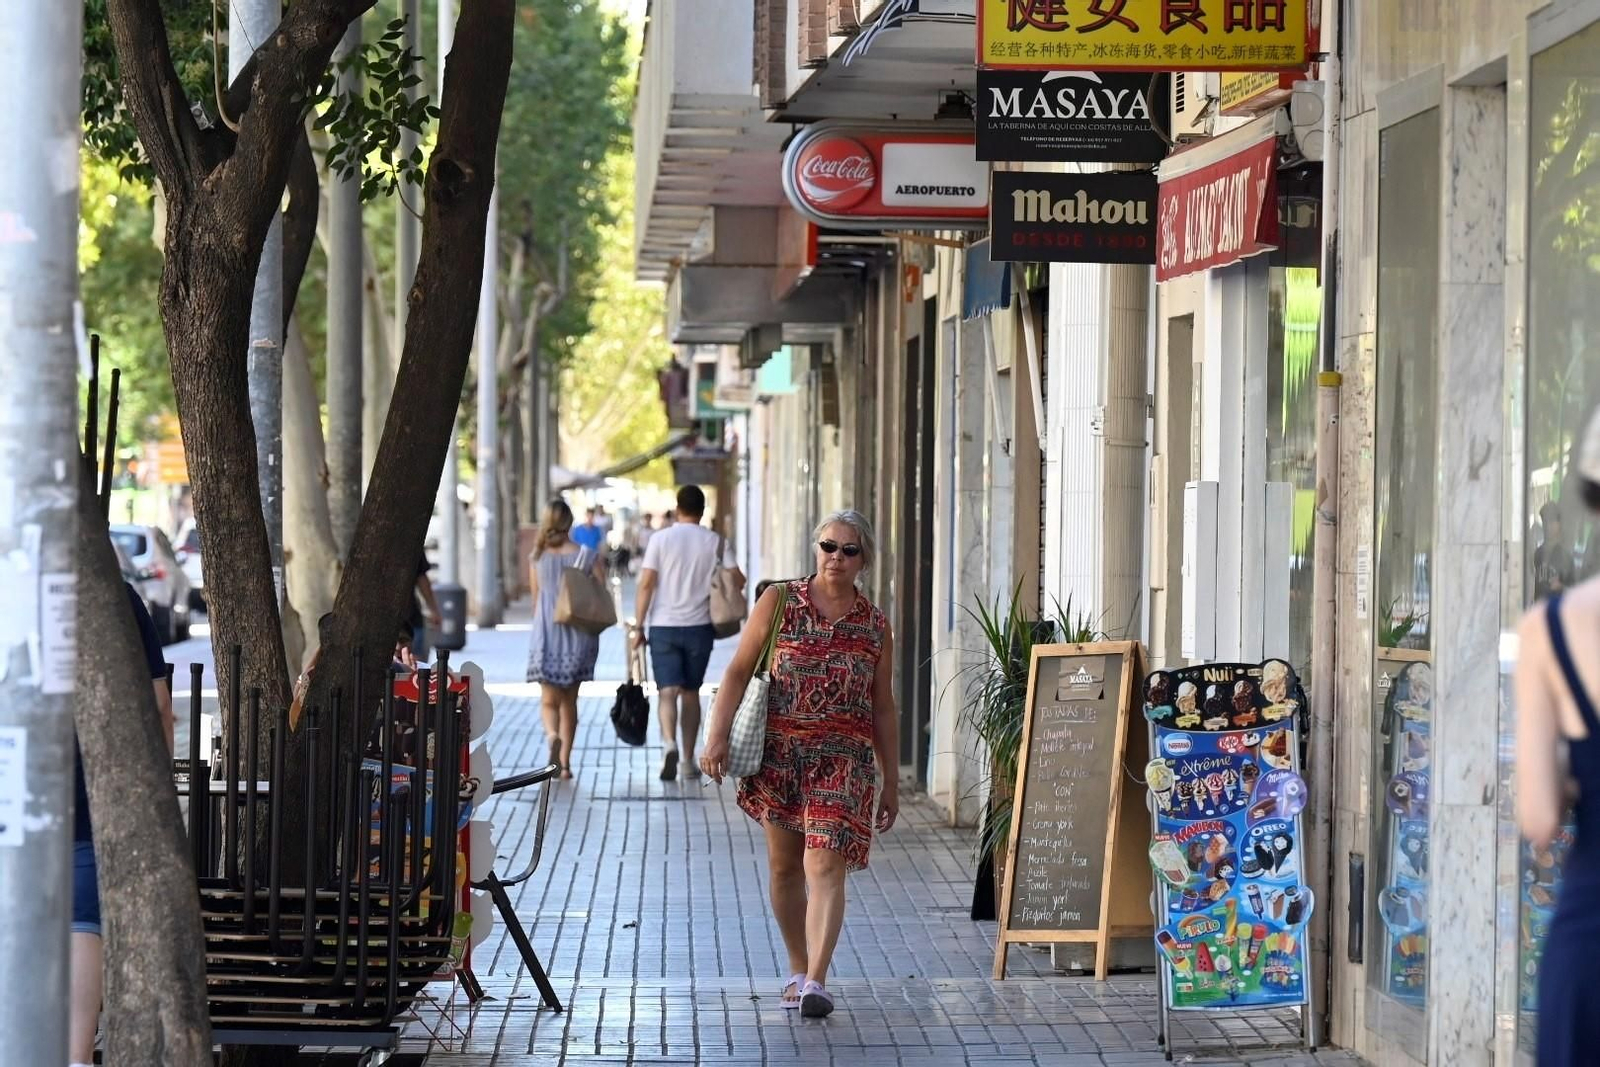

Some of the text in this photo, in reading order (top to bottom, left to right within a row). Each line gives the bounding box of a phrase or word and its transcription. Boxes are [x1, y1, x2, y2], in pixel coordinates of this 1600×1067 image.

[988, 87, 1150, 119] MASAYA
[988, 122, 998, 130] LA
[1000, 122, 1036, 130] TABERNA
[1070, 123, 1088, 131] CON
[1088, 123, 1121, 131] COSITAS
[1122, 123, 1134, 131] DE
[896, 185, 976, 197] AEROPUERTO
[1011, 189, 1148, 224] Mahou
[1012, 232, 1084, 246] DESDE
[1252, 823, 1287, 837] OREO
